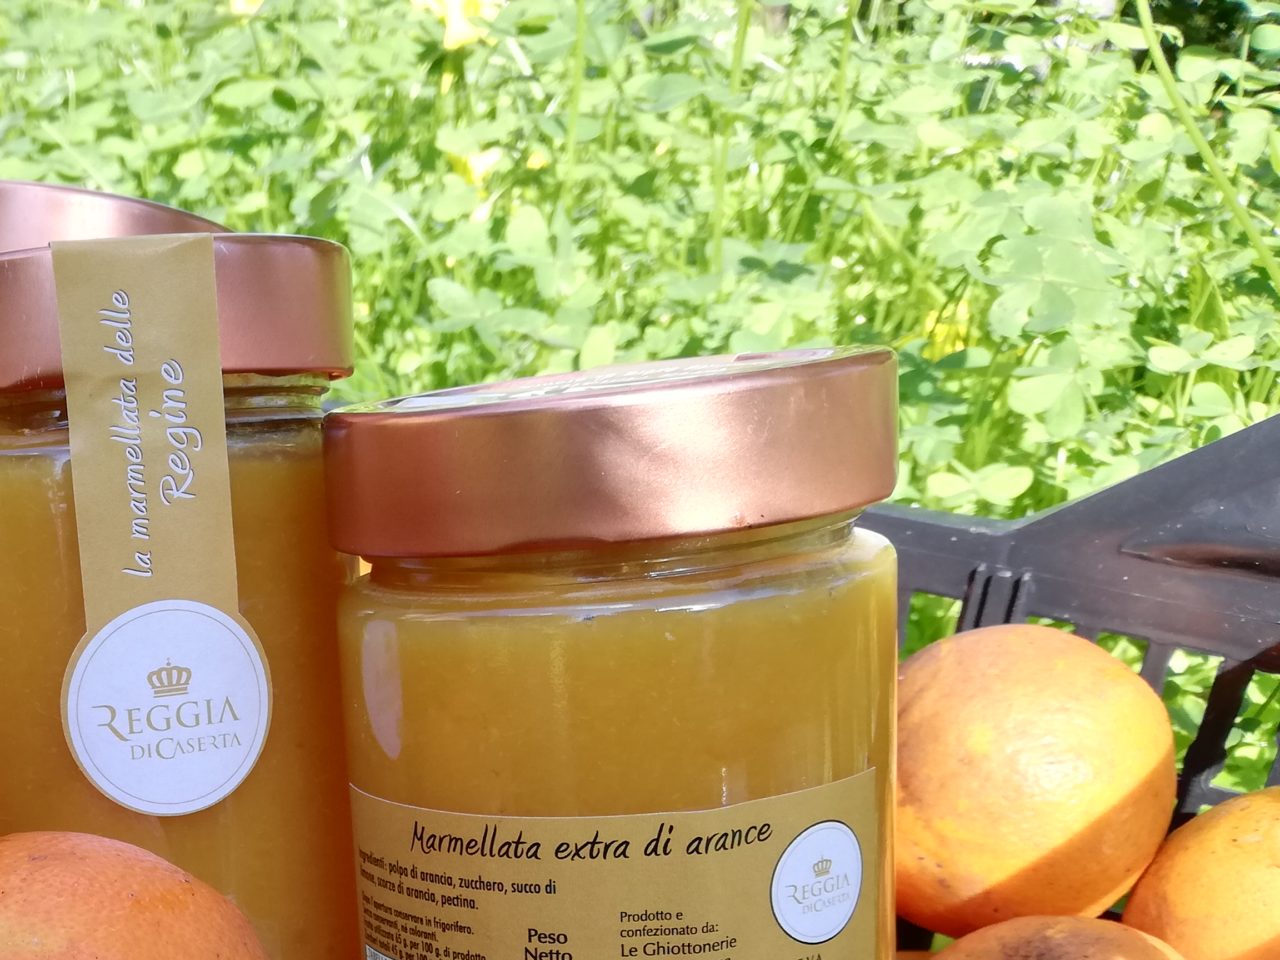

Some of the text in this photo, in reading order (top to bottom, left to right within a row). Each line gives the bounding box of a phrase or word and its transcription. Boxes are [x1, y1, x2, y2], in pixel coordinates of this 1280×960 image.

[99, 288, 153, 578] la marmellata delle
[151, 358, 202, 506] Regine
[91, 695, 241, 741] REGGIA
[410, 820, 773, 862] Marmellata extra di arance
[388, 862, 409, 879] polpa
[410, 865, 418, 879] di
[420, 871, 456, 889] arancia,
[458, 875, 508, 895] zucchero,
[511, 881, 541, 894] succo
[545, 879, 556, 894] di
[785, 873, 850, 904] REGGIA
[406, 886, 439, 906] arancia,
[441, 894, 479, 910] pectina.
[433, 917, 474, 935] frigorifero.
[620, 910, 683, 922] Prodotto e
[409, 925, 439, 942] coloranti.
[527, 927, 569, 945] Peso
[620, 922, 719, 938] confezionato da:
[409, 939, 420, 952] per
[421, 940, 433, 954] 100
[435, 946, 441, 958] g.
[443, 946, 450, 958] di
[621, 936, 737, 957] Le Ghiottonerie
